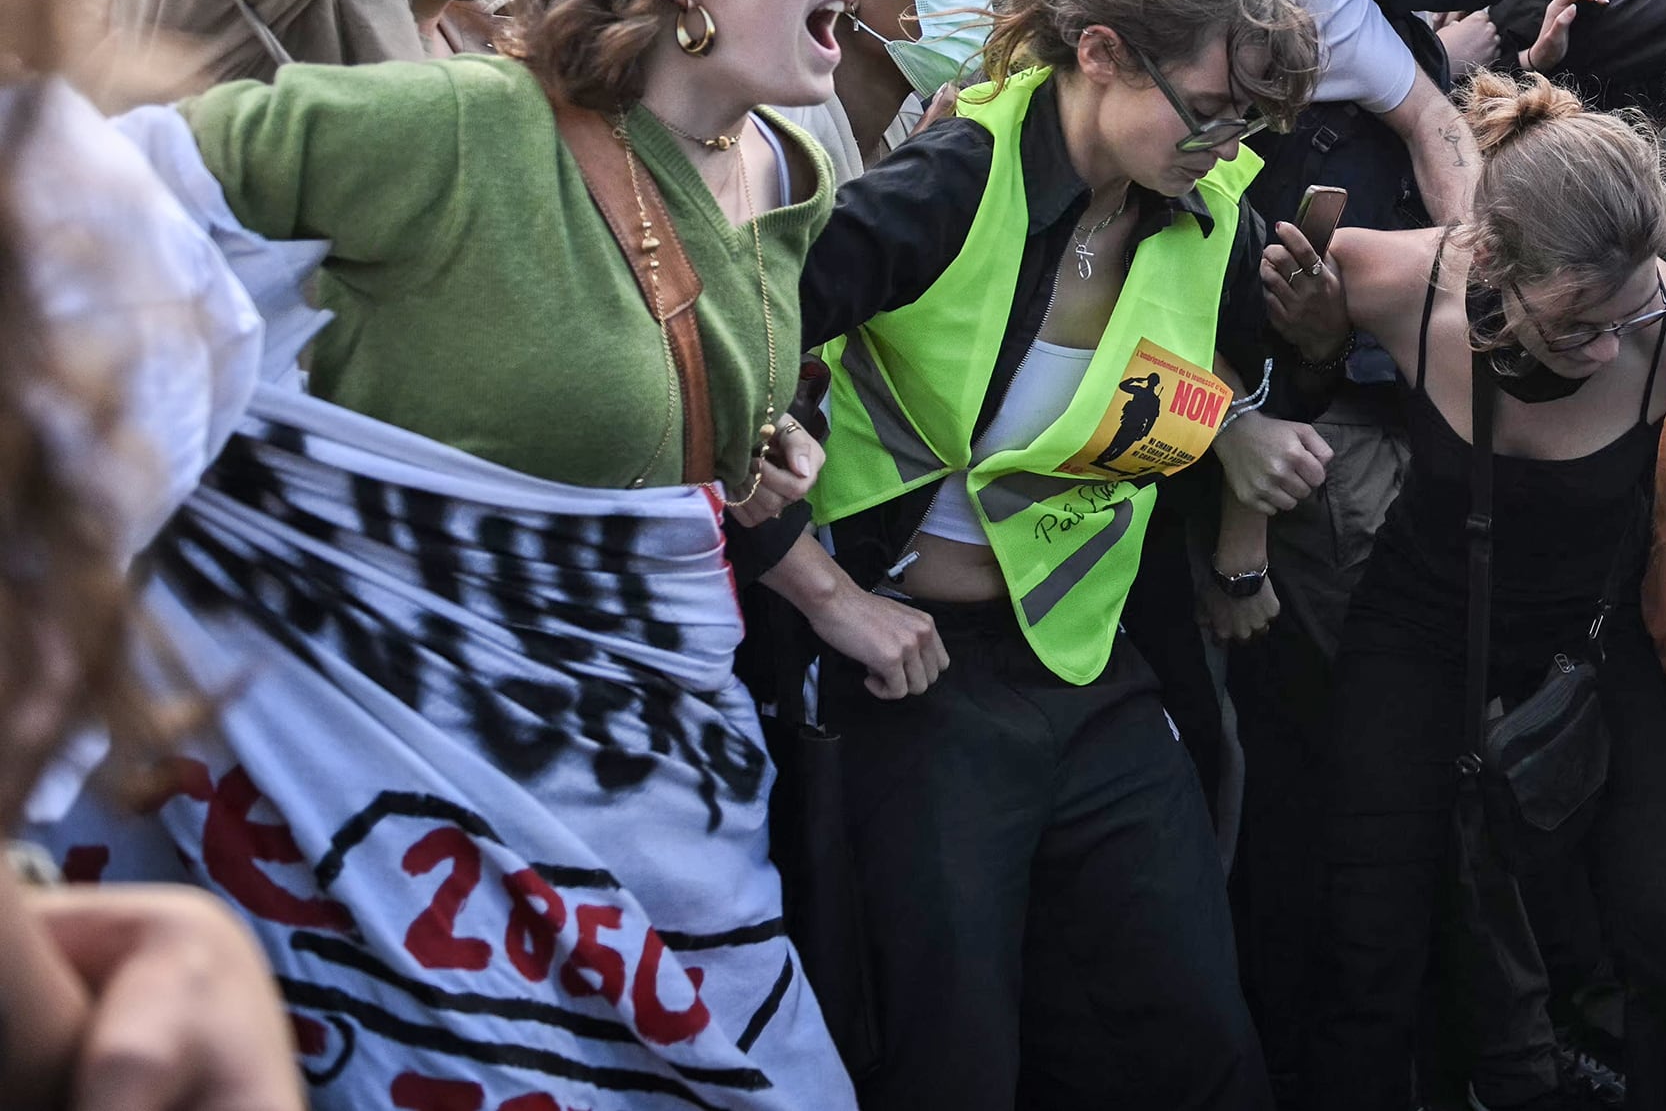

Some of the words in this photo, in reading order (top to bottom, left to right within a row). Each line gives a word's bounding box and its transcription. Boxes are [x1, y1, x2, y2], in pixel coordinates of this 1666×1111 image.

[1179, 368, 1186, 377] de
[1186, 371, 1192, 379] la
[1191, 373, 1216, 389] jeunesse
[1169, 379, 1225, 429] NON
[1140, 444, 1149, 452] NI
[1147, 447, 1165, 459] CHAIR
[1149, 437, 1157, 446] NI
[1155, 440, 1174, 453] CHAIR
[1131, 450, 1140, 458] NI
[1138, 452, 1156, 463] CHAIR
